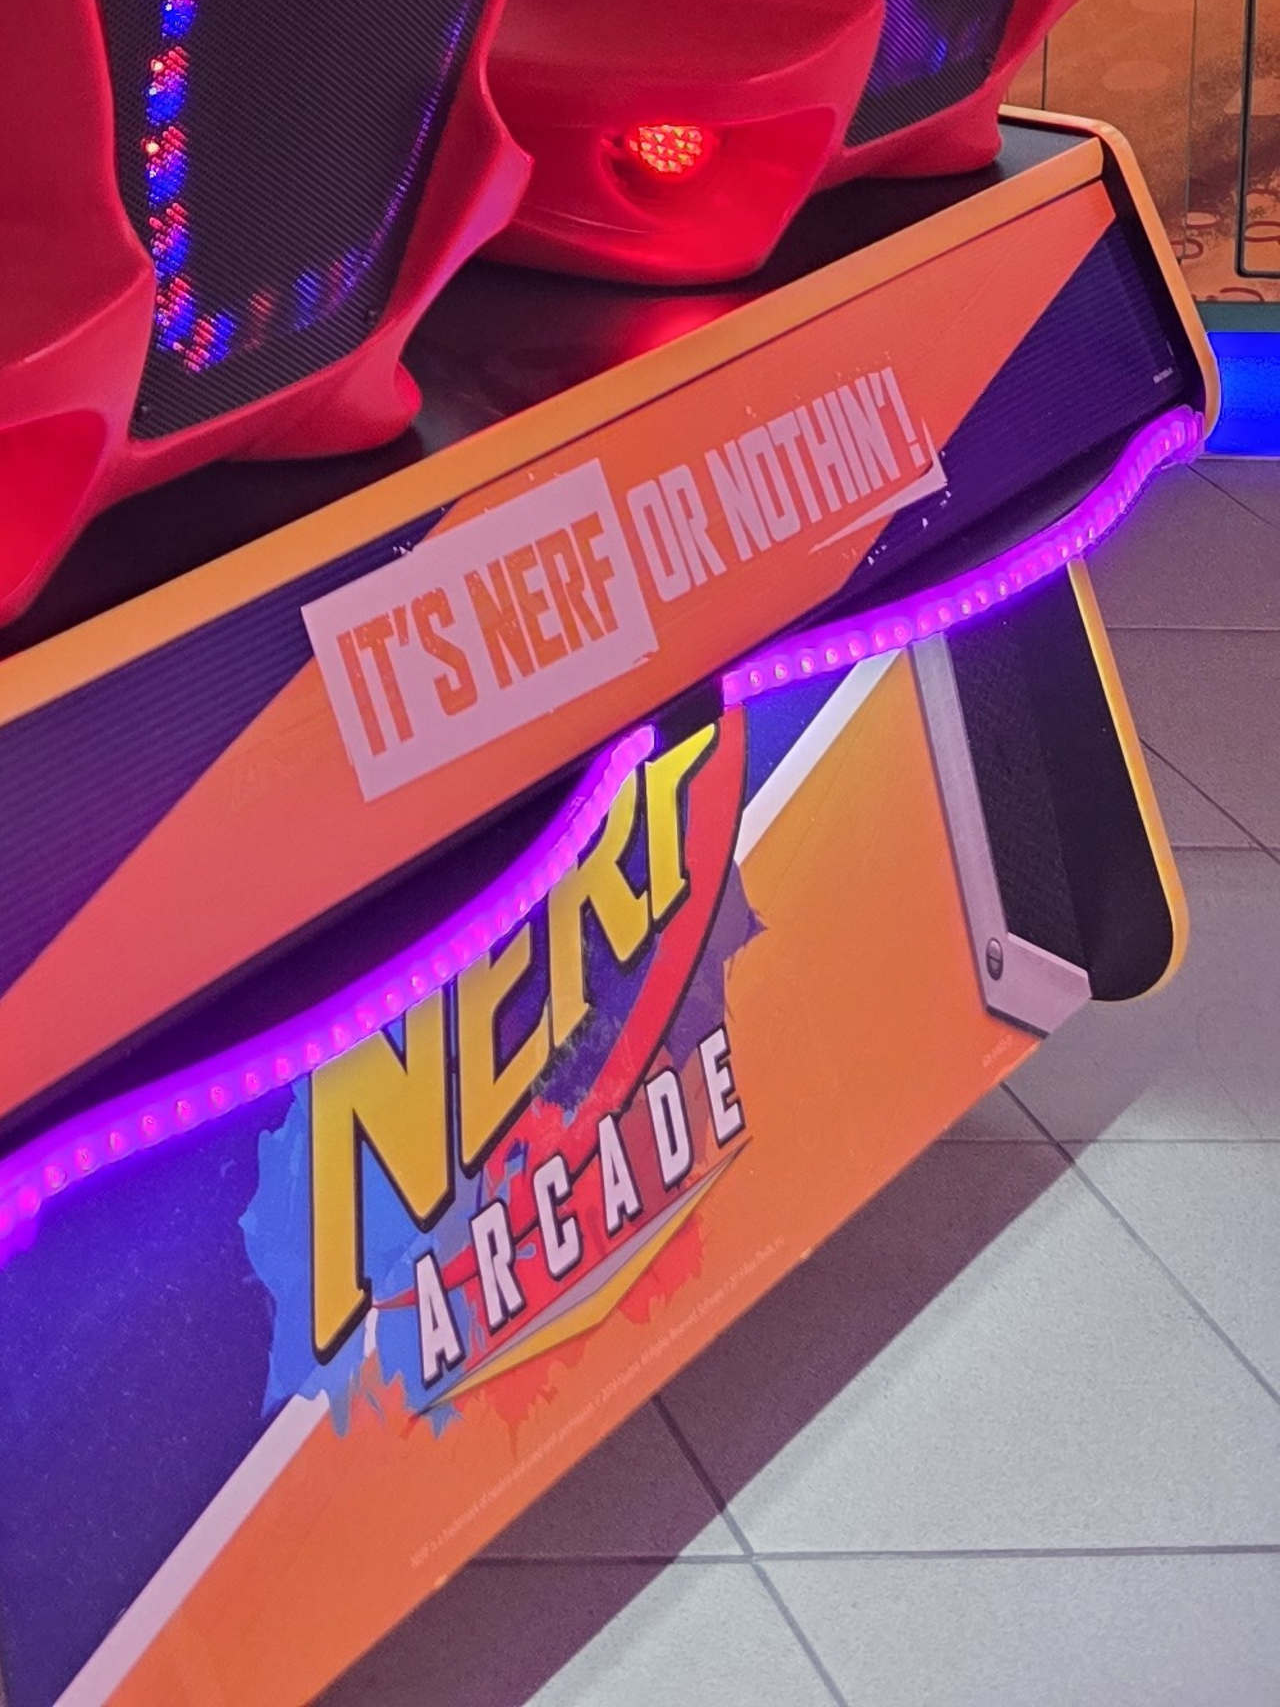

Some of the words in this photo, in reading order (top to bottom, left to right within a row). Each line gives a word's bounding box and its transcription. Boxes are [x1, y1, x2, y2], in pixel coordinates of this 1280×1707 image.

[336, 585, 478, 759] IT'S
[464, 512, 620, 691] NERF
[627, 463, 726, 604] OR
[705, 366, 926, 563] NOTHIN'!
[415, 1025, 745, 1386] ARCADE
